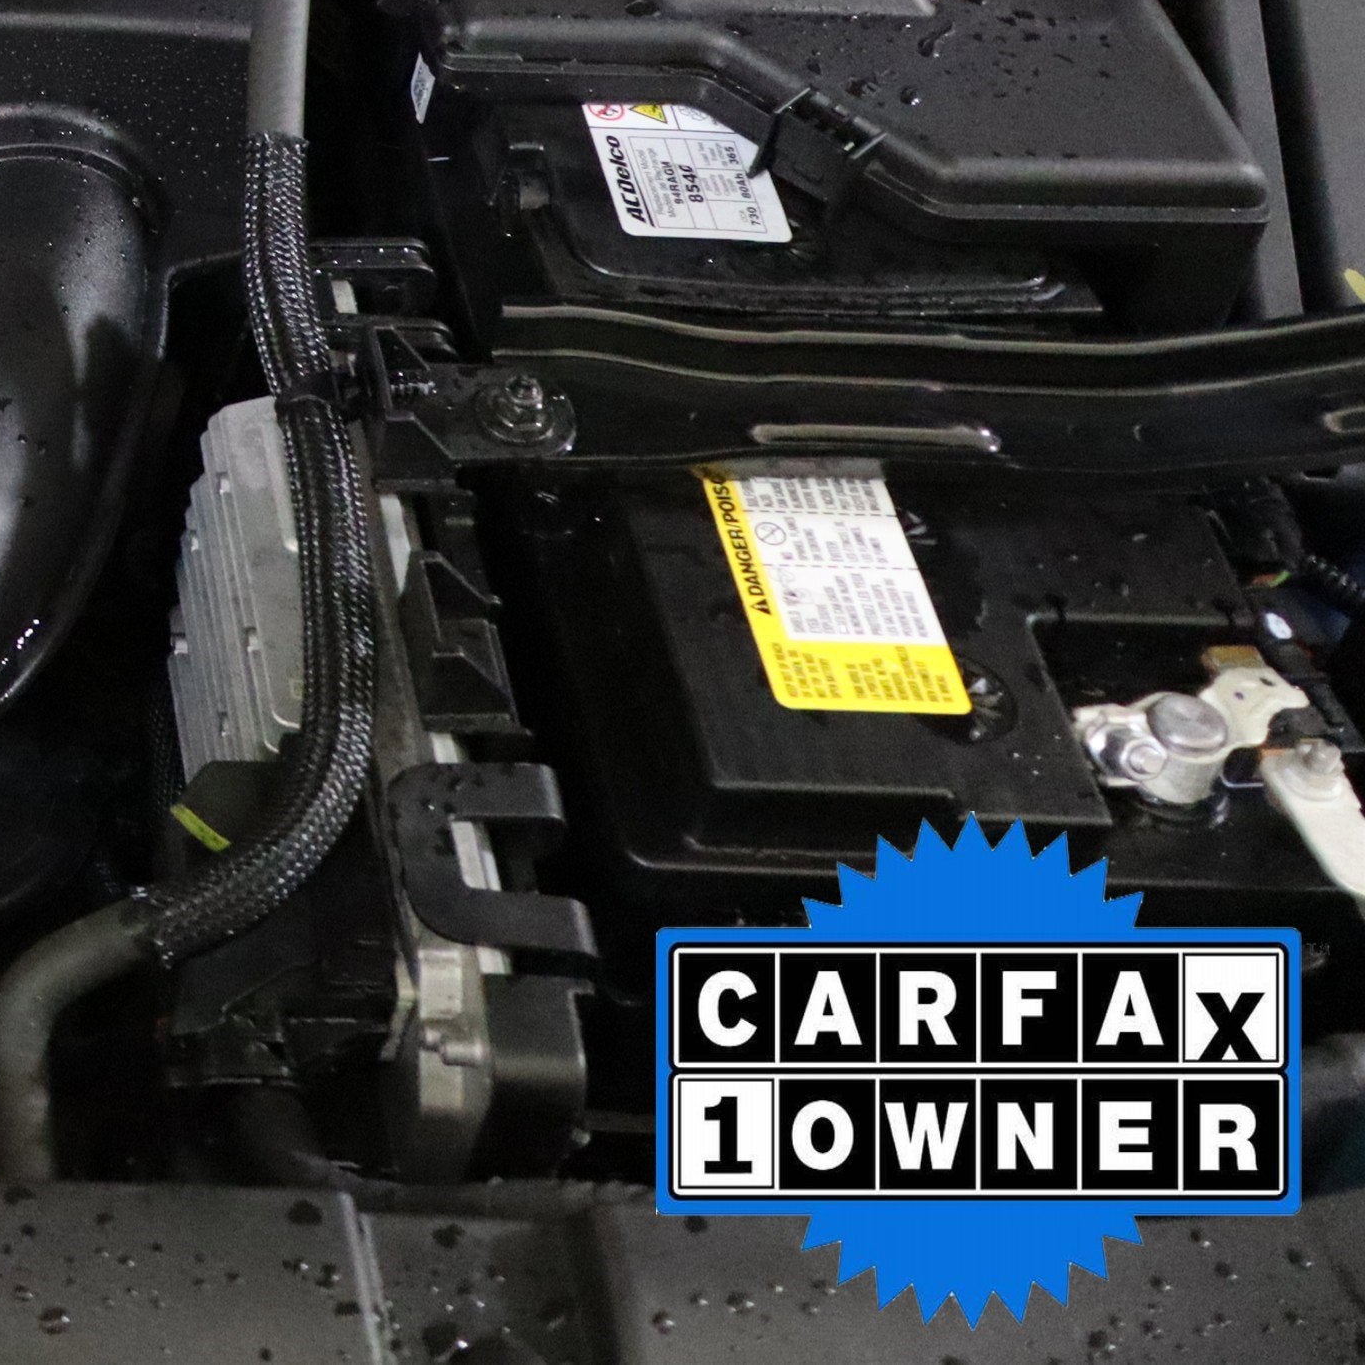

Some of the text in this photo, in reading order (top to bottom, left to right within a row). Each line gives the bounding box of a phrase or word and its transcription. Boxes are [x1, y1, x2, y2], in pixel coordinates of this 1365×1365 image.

[724, 146, 739, 164] 365
[606, 135, 646, 223] ACDelco
[732, 172, 751, 198] 80Ah
[745, 206, 762, 226] 730
